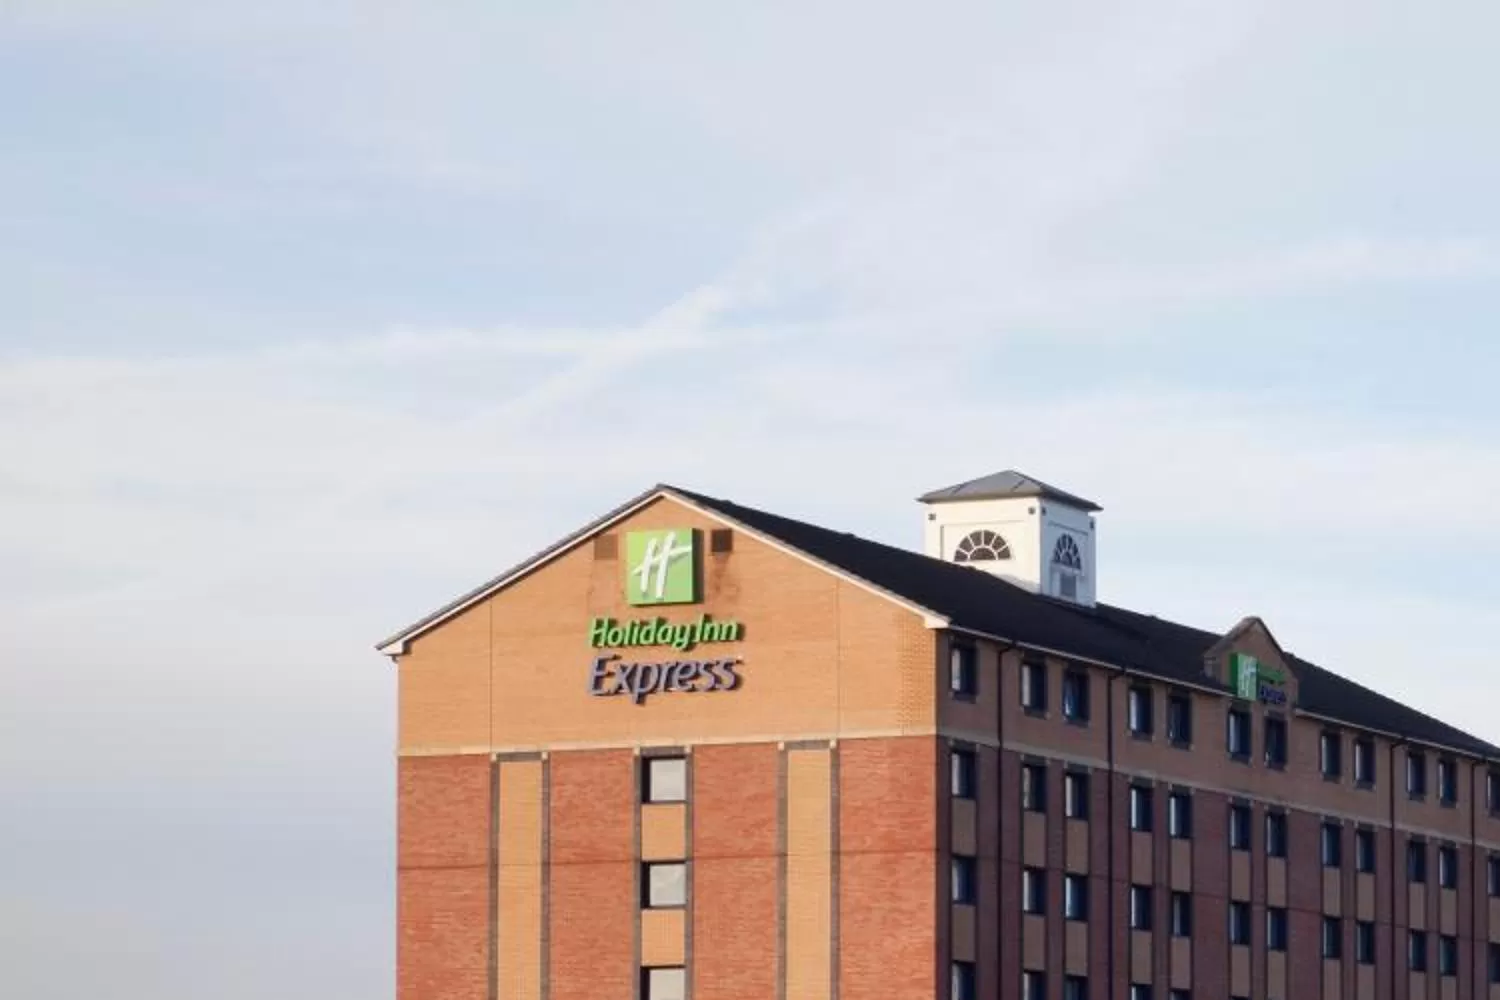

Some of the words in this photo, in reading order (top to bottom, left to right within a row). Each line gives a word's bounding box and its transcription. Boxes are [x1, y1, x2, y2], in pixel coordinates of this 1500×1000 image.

[590, 617, 690, 649] Holiday
[694, 614, 742, 642] Inn
[589, 651, 742, 703] Express
